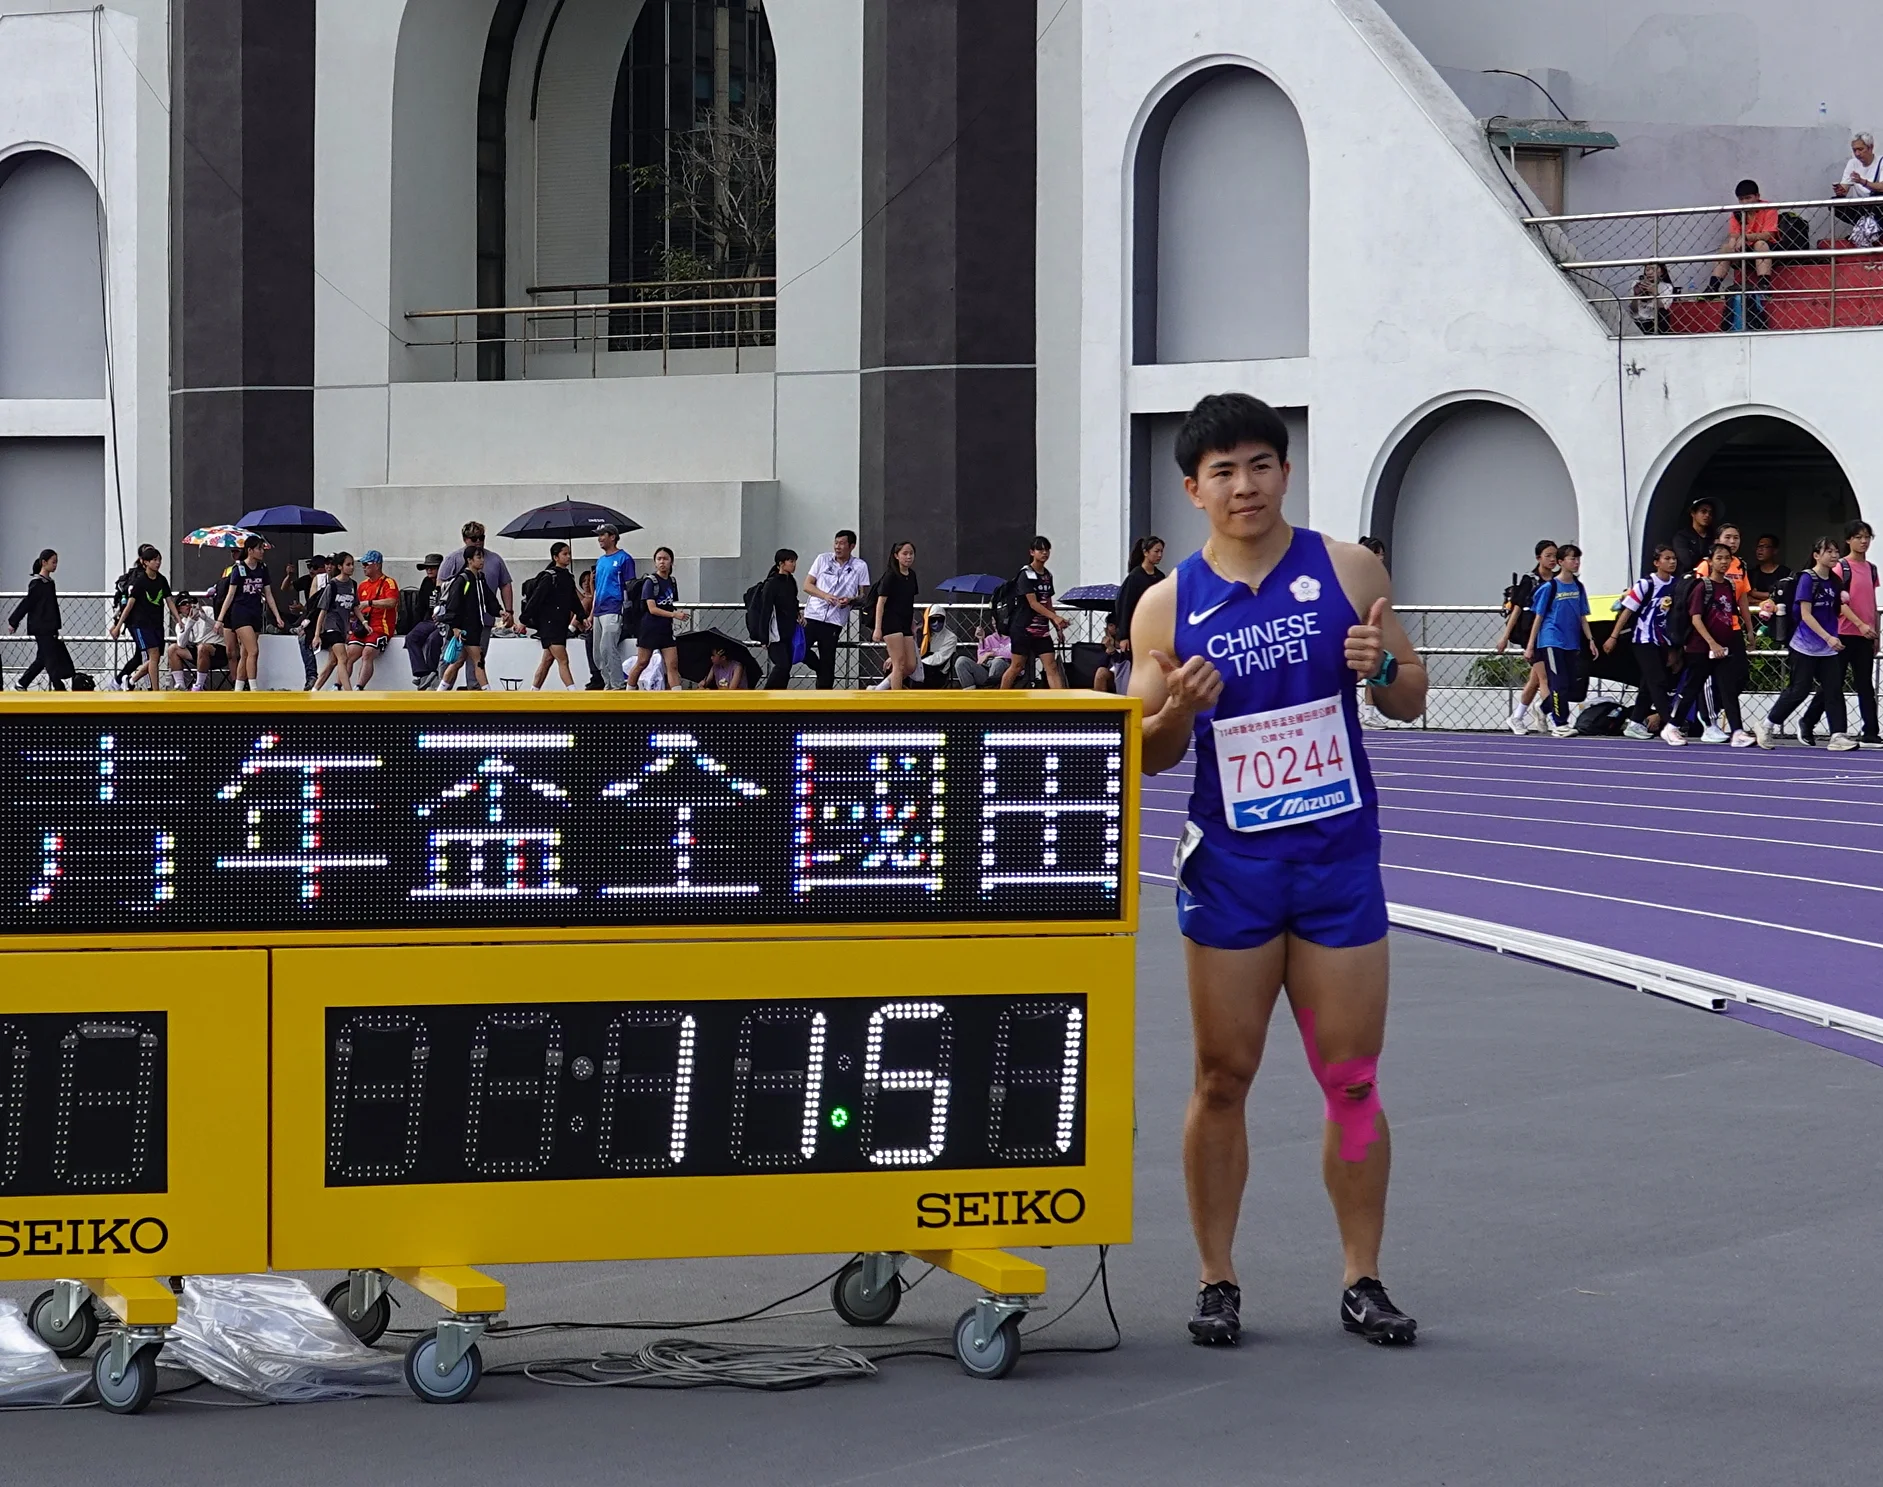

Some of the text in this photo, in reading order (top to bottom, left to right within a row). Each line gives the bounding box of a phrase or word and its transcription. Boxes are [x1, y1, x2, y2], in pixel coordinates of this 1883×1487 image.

[1206, 612, 1322, 659] CHINESE
[1228, 639, 1308, 677] TAIPEI
[1228, 734, 1343, 793] 70244
[916, 1187, 1086, 1229] SEIKO
